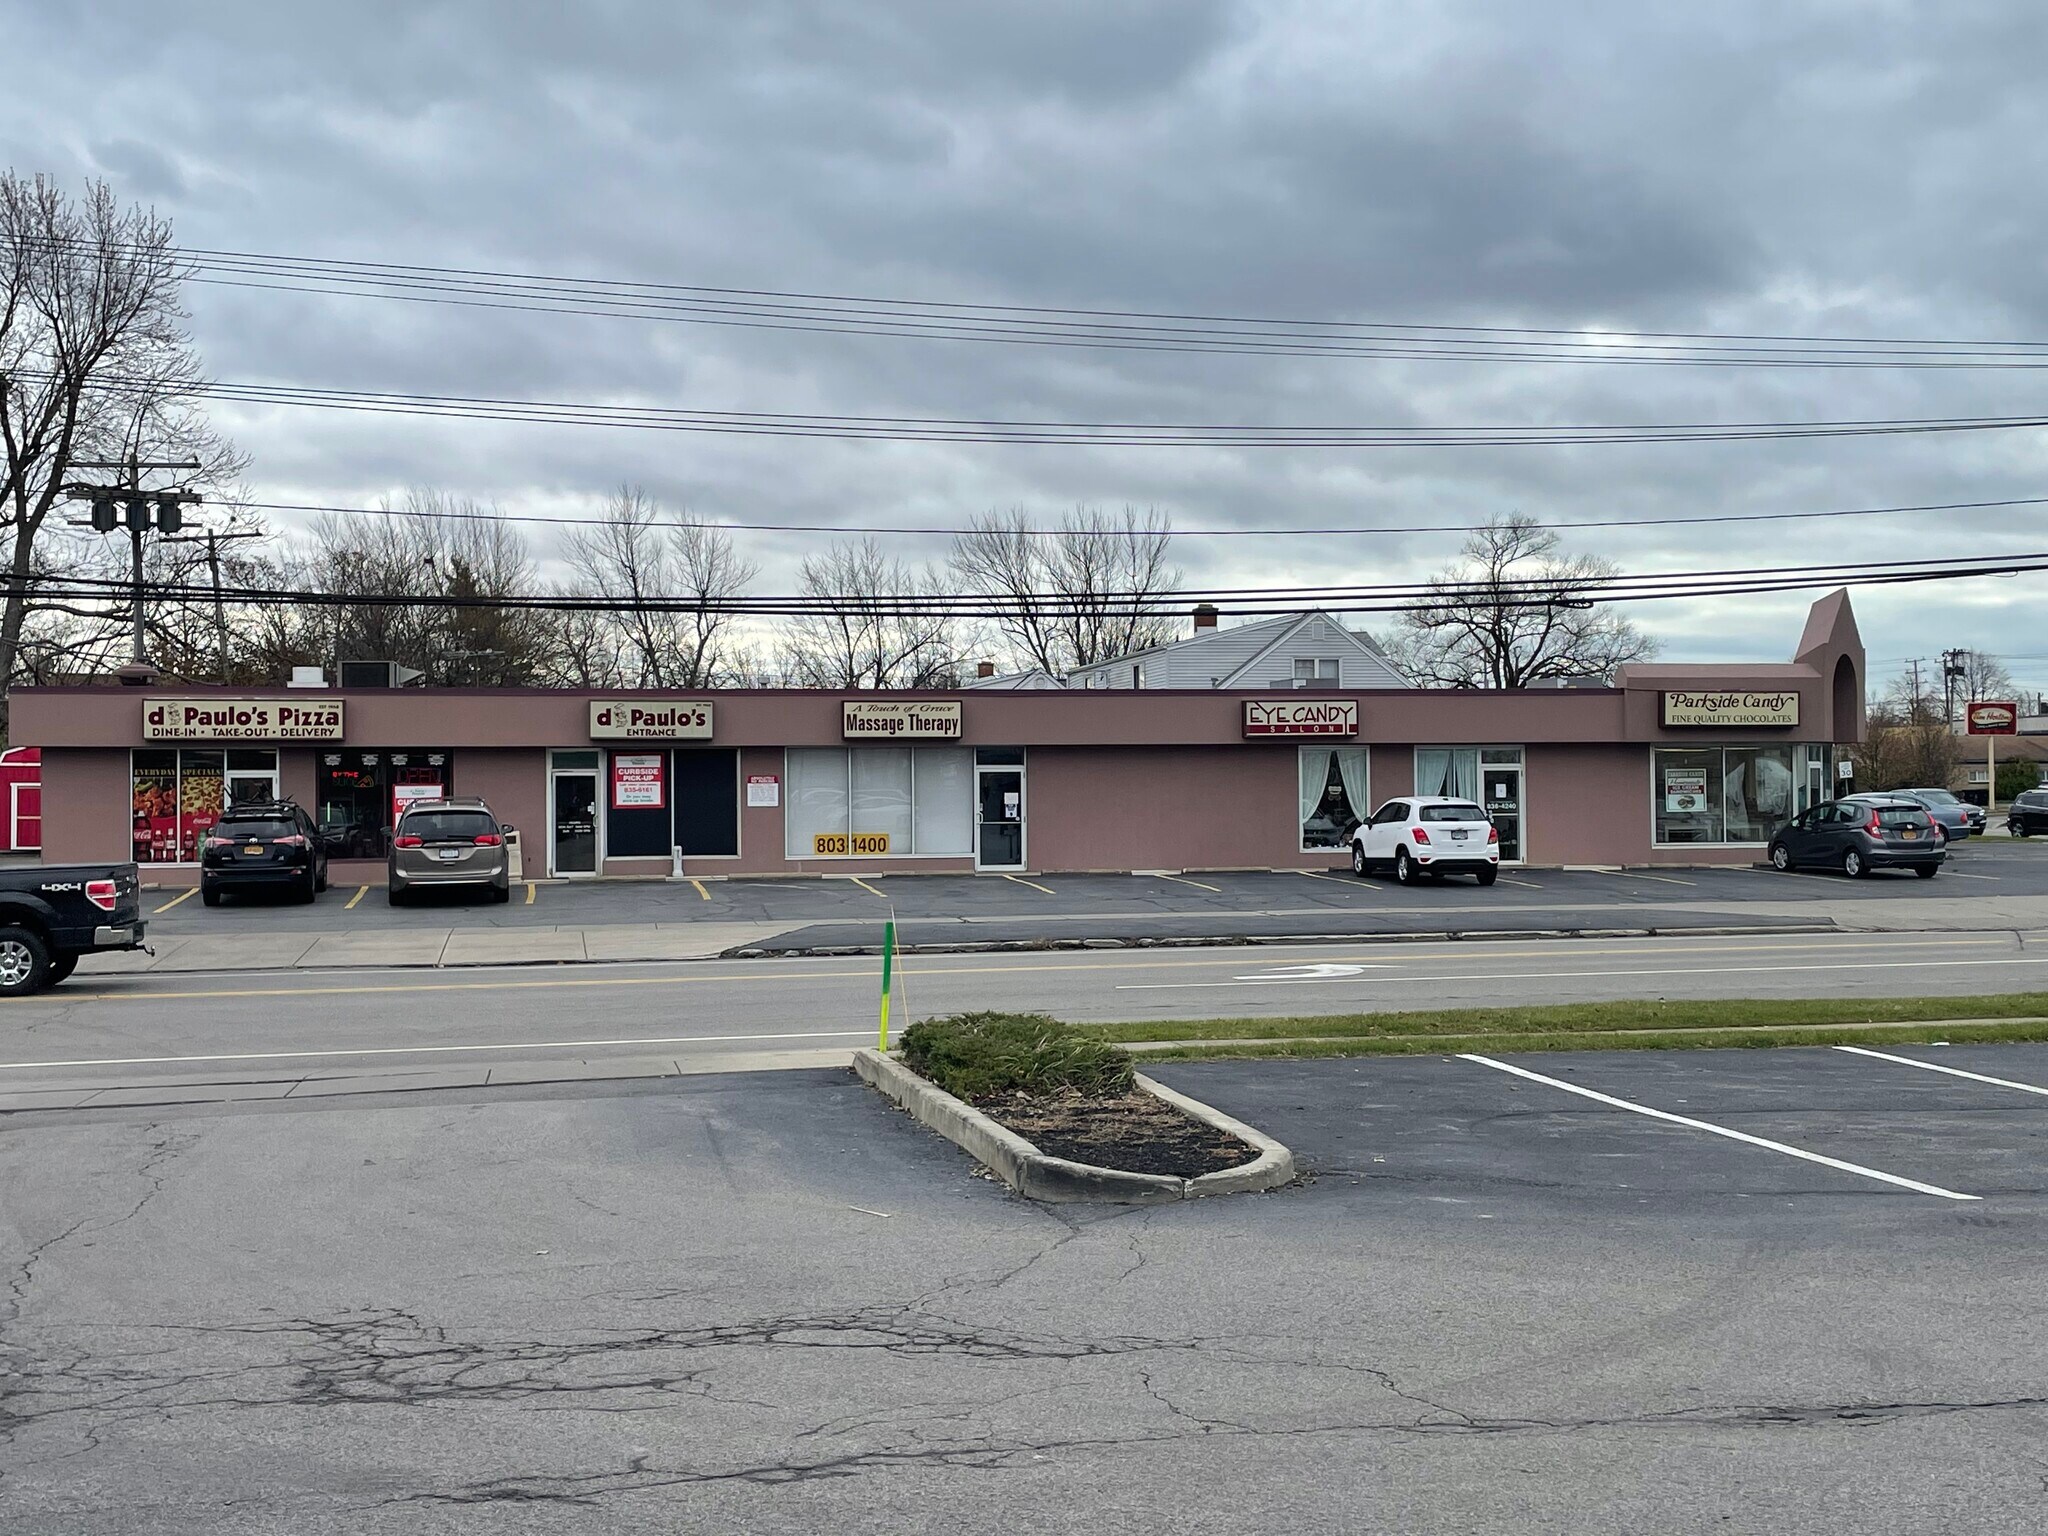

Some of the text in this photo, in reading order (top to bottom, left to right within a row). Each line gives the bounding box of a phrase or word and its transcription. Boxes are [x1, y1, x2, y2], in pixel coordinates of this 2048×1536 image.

[1670, 693, 1795, 712] Parkside Candy
[852, 704, 955, 713] A Touch of Grace
[184, 706, 268, 726] Paulo's
[278, 707, 340, 726] Pizza
[631, 708, 706, 726] Paulo's
[1250, 701, 1354, 735] EYE CANDY
[1672, 715, 1792, 724] FINE QUALITY CHOCOLATES
[846, 714, 959, 735] Massage Therapy
[152, 728, 335, 737] DINE-IN TAKE-OUT DELIVERY
[626, 729, 677, 737] ENTRANCE
[134, 768, 176, 776] EVERYDAY
[1841, 769, 1852, 777] 30
